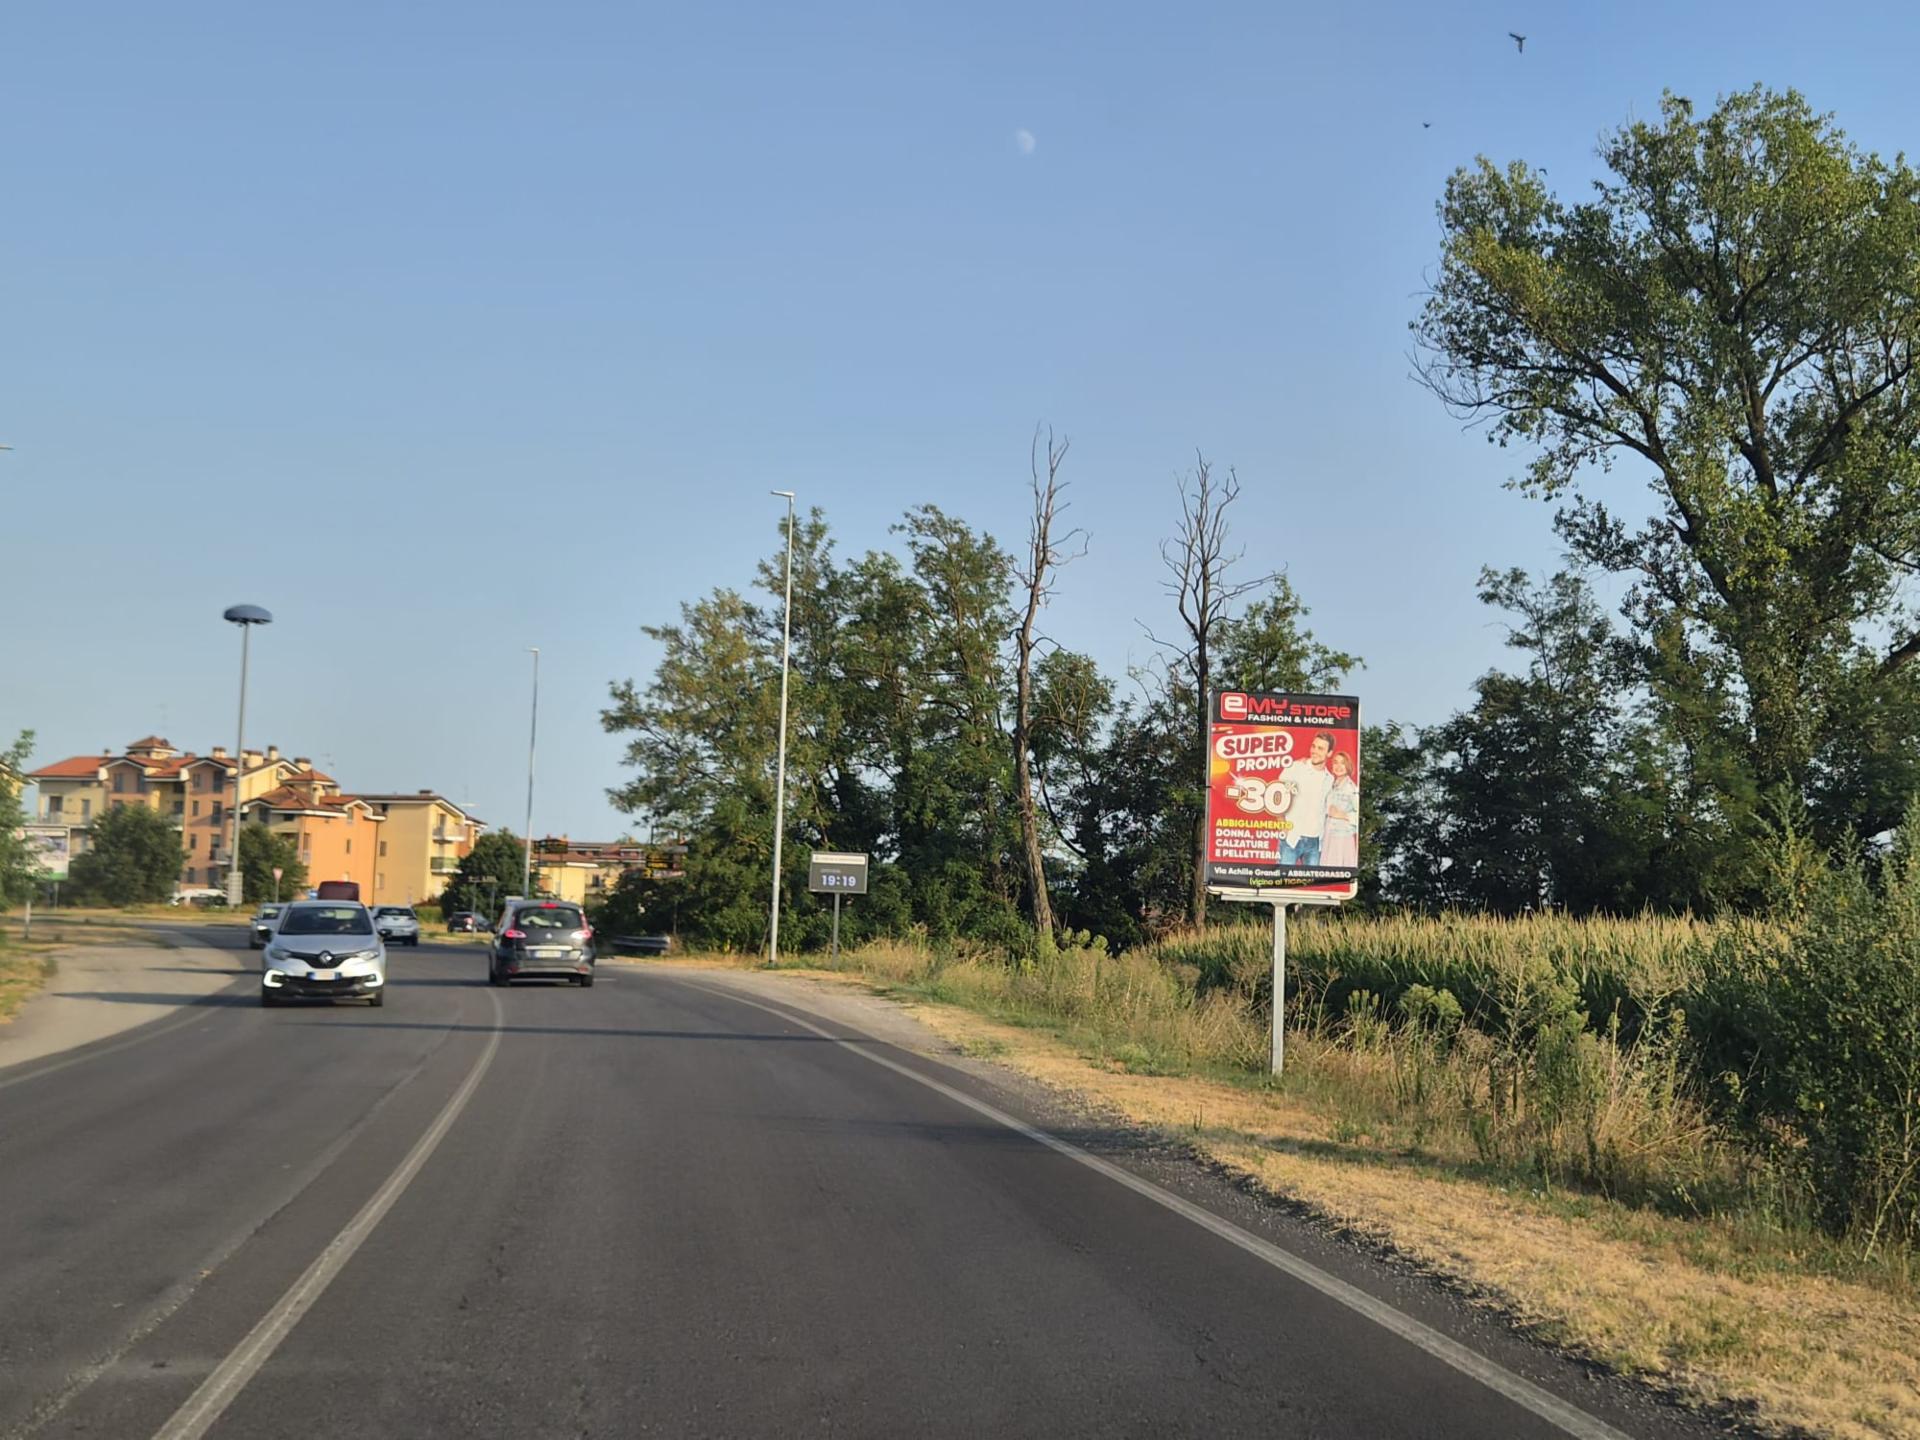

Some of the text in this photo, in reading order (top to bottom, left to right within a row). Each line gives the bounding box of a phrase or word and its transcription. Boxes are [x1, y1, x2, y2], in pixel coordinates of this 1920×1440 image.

[1249, 697, 1288, 714] MY
[1247, 714, 1292, 723] FASHION
[1304, 717, 1334, 725] HOME
[1223, 735, 1288, 756] SUPER
[1236, 755, 1293, 771] PROMO
[1216, 819, 1293, 829] ABBIGLIAMENTO
[1216, 829, 1287, 839] DONNA, UOMO
[1216, 839, 1269, 849] CALZATURE
[1215, 849, 1281, 860] E PELLETTERIA
[1214, 867, 1227, 875] Via
[1228, 868, 1253, 876] Achille
[1255, 869, 1281, 877] Grandi
[822, 875, 856, 887] 19:19
